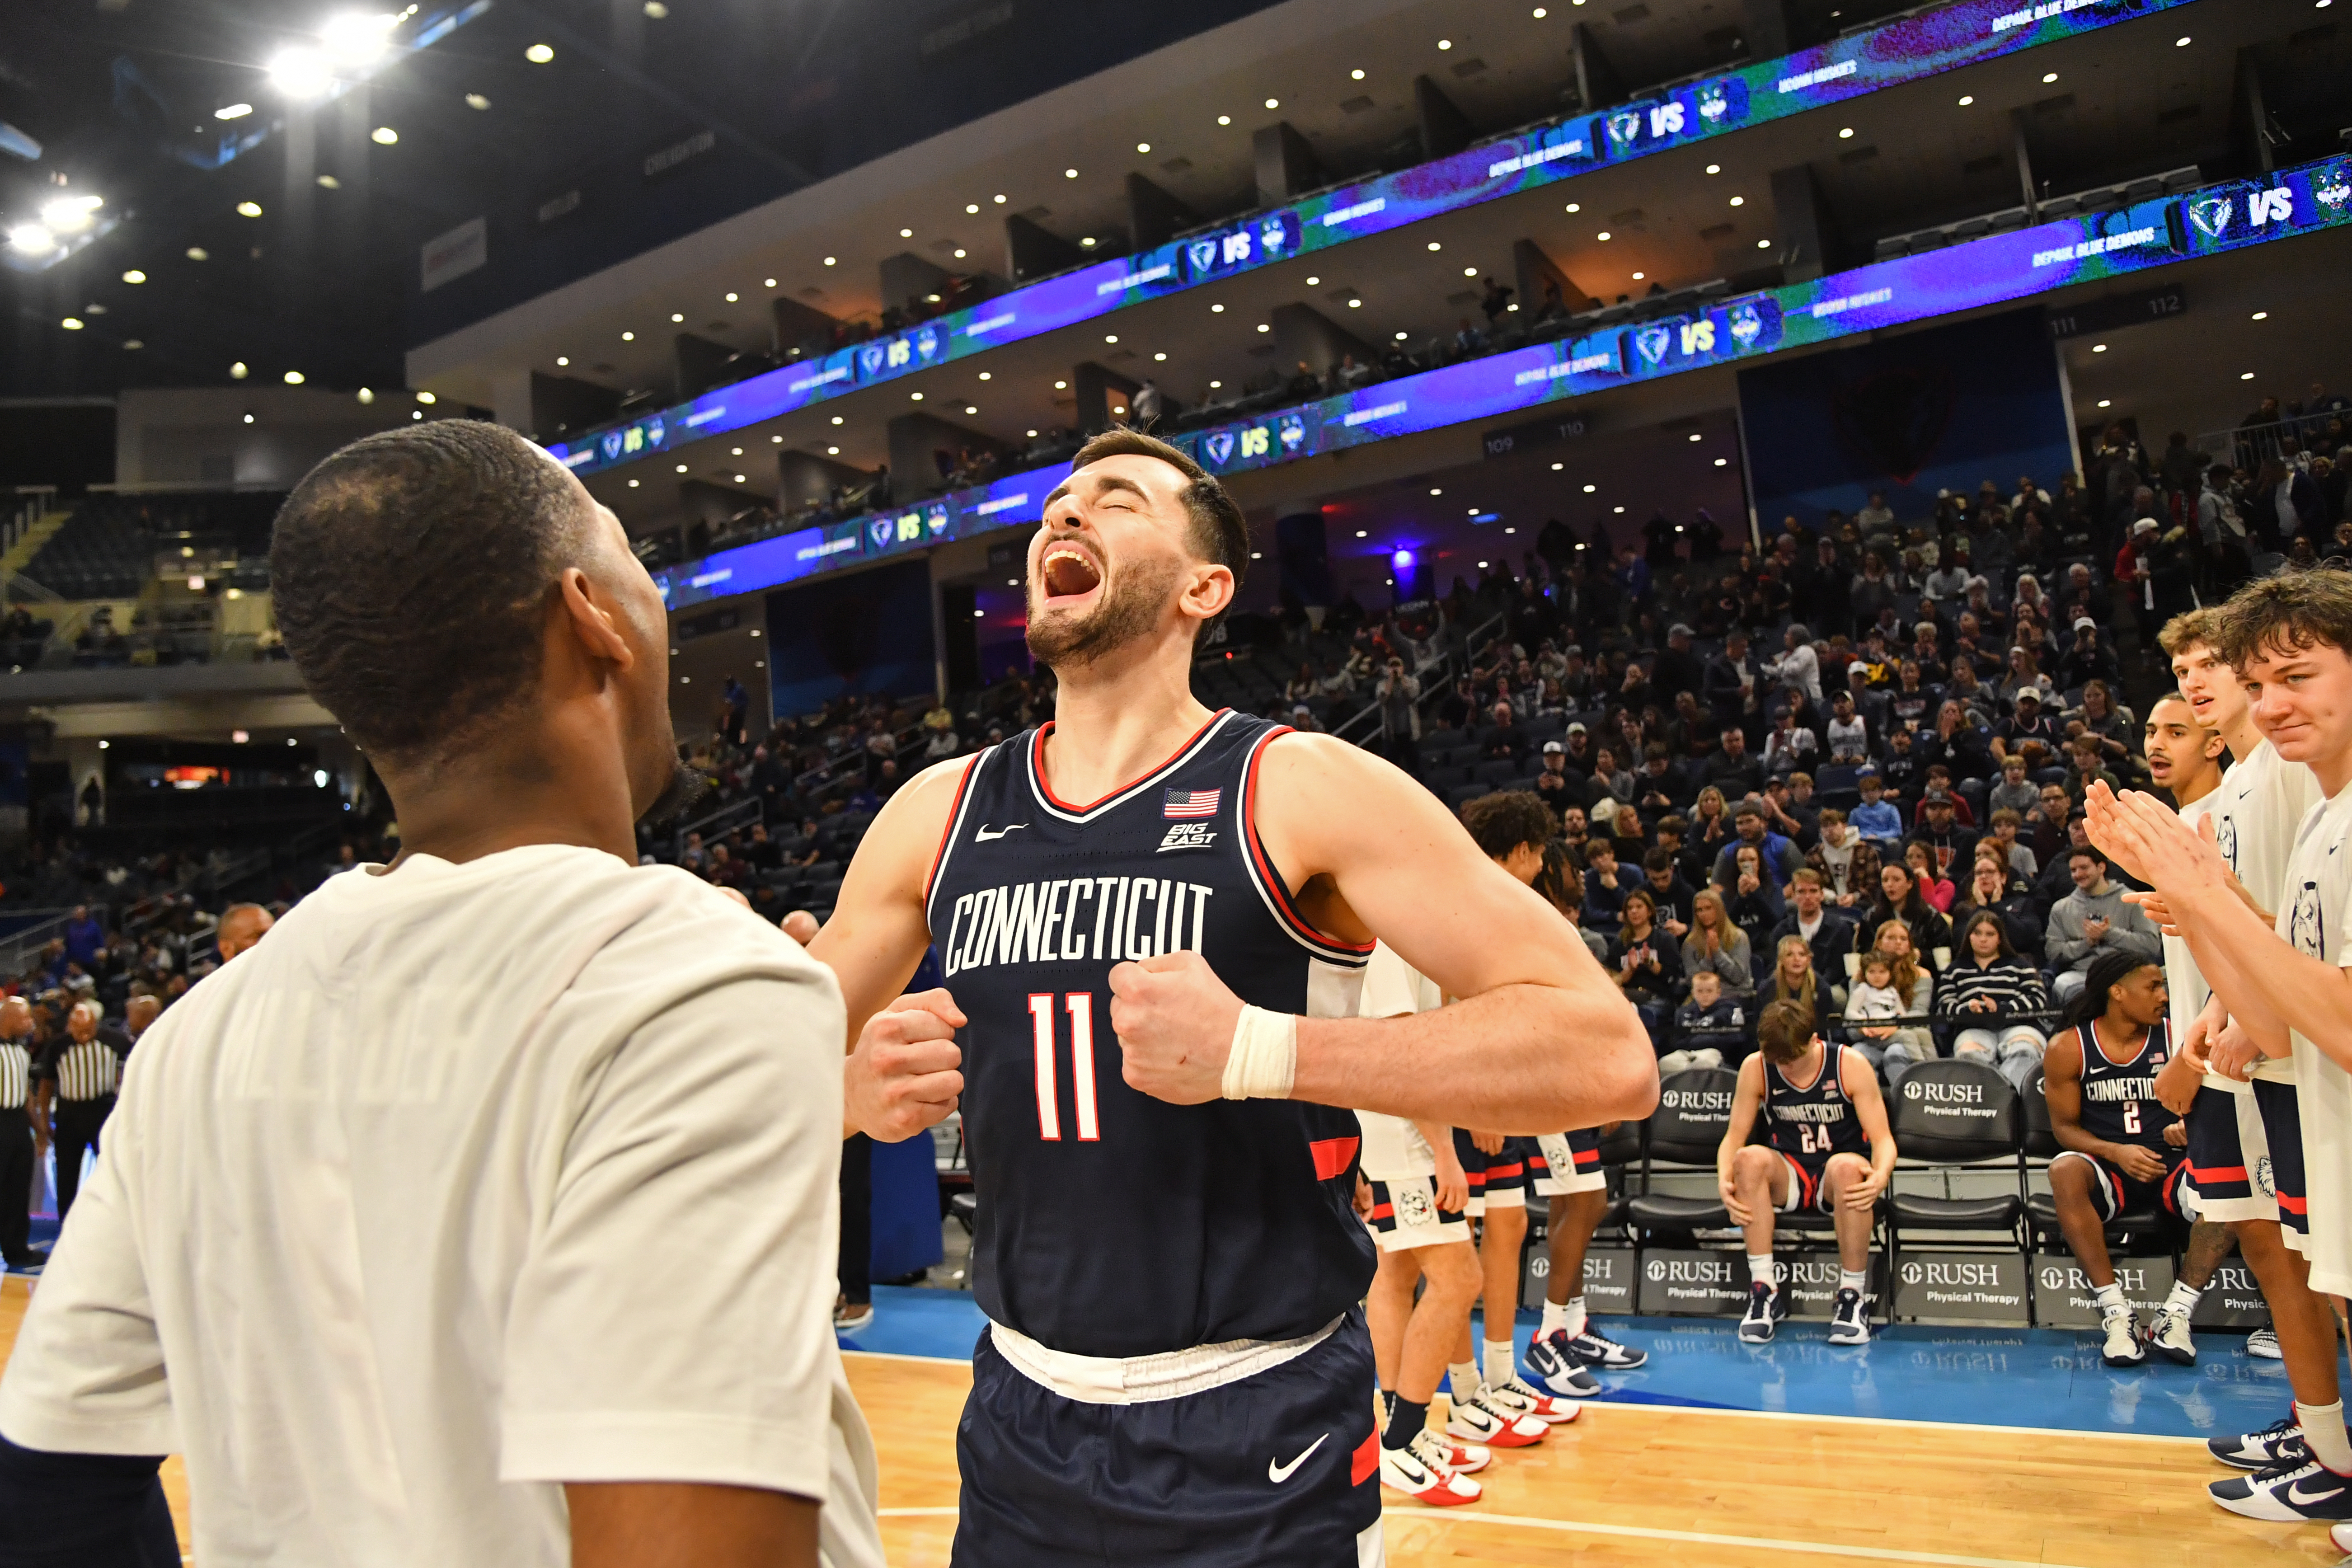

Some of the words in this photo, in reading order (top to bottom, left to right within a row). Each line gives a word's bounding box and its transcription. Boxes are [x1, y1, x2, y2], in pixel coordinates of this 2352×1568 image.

[1992, 9, 2034, 32] DEPAUL
[2035, 0, 2062, 19] BLUE
[1650, 101, 1685, 137] VS
[2249, 187, 2292, 226] VS
[1223, 231, 1251, 263] VS
[2033, 246, 2075, 267] DEPAUL
[2076, 238, 2105, 258] BLUE
[2106, 227, 2154, 251] DEMONS
[2148, 295, 2180, 315] 112
[1680, 319, 1715, 355] VS
[1559, 420, 1584, 438] 110
[1241, 426, 1269, 458] VS
[1486, 436, 1514, 454] 109
[1167, 822, 1209, 835] BIG
[1160, 833, 1217, 846] EAST
[945, 877, 1213, 977] CONNECTICUT
[1028, 992, 1100, 1141] 11
[1680, 1091, 1732, 1109] RUSH
[1925, 1083, 1983, 1103] RUSH
[1679, 1112, 1712, 1122] Physical
[1924, 1105, 1960, 1116] Physical
[1962, 1108, 1997, 1118] Therapy
[2123, 1100, 2142, 1134] 2
[1797, 1123, 1833, 1154] 24
[1583, 1258, 1612, 1279] SH
[1668, 1261, 1732, 1282] RUSH
[1791, 1262, 1842, 1283] RUS
[1925, 1263, 2000, 1286] RUSH
[2219, 1268, 2259, 1290] RU
[1589, 1284, 1627, 1296] Therapy
[1668, 1287, 1707, 1299] Physical
[1708, 1288, 1748, 1300] Therapy
[1791, 1289, 1833, 1301] Physical
[1926, 1291, 1972, 1303] Physical
[1973, 1292, 2019, 1305] Therapy
[2069, 1297, 2101, 1309] Physi
[2224, 1298, 2269, 1310] Physic
